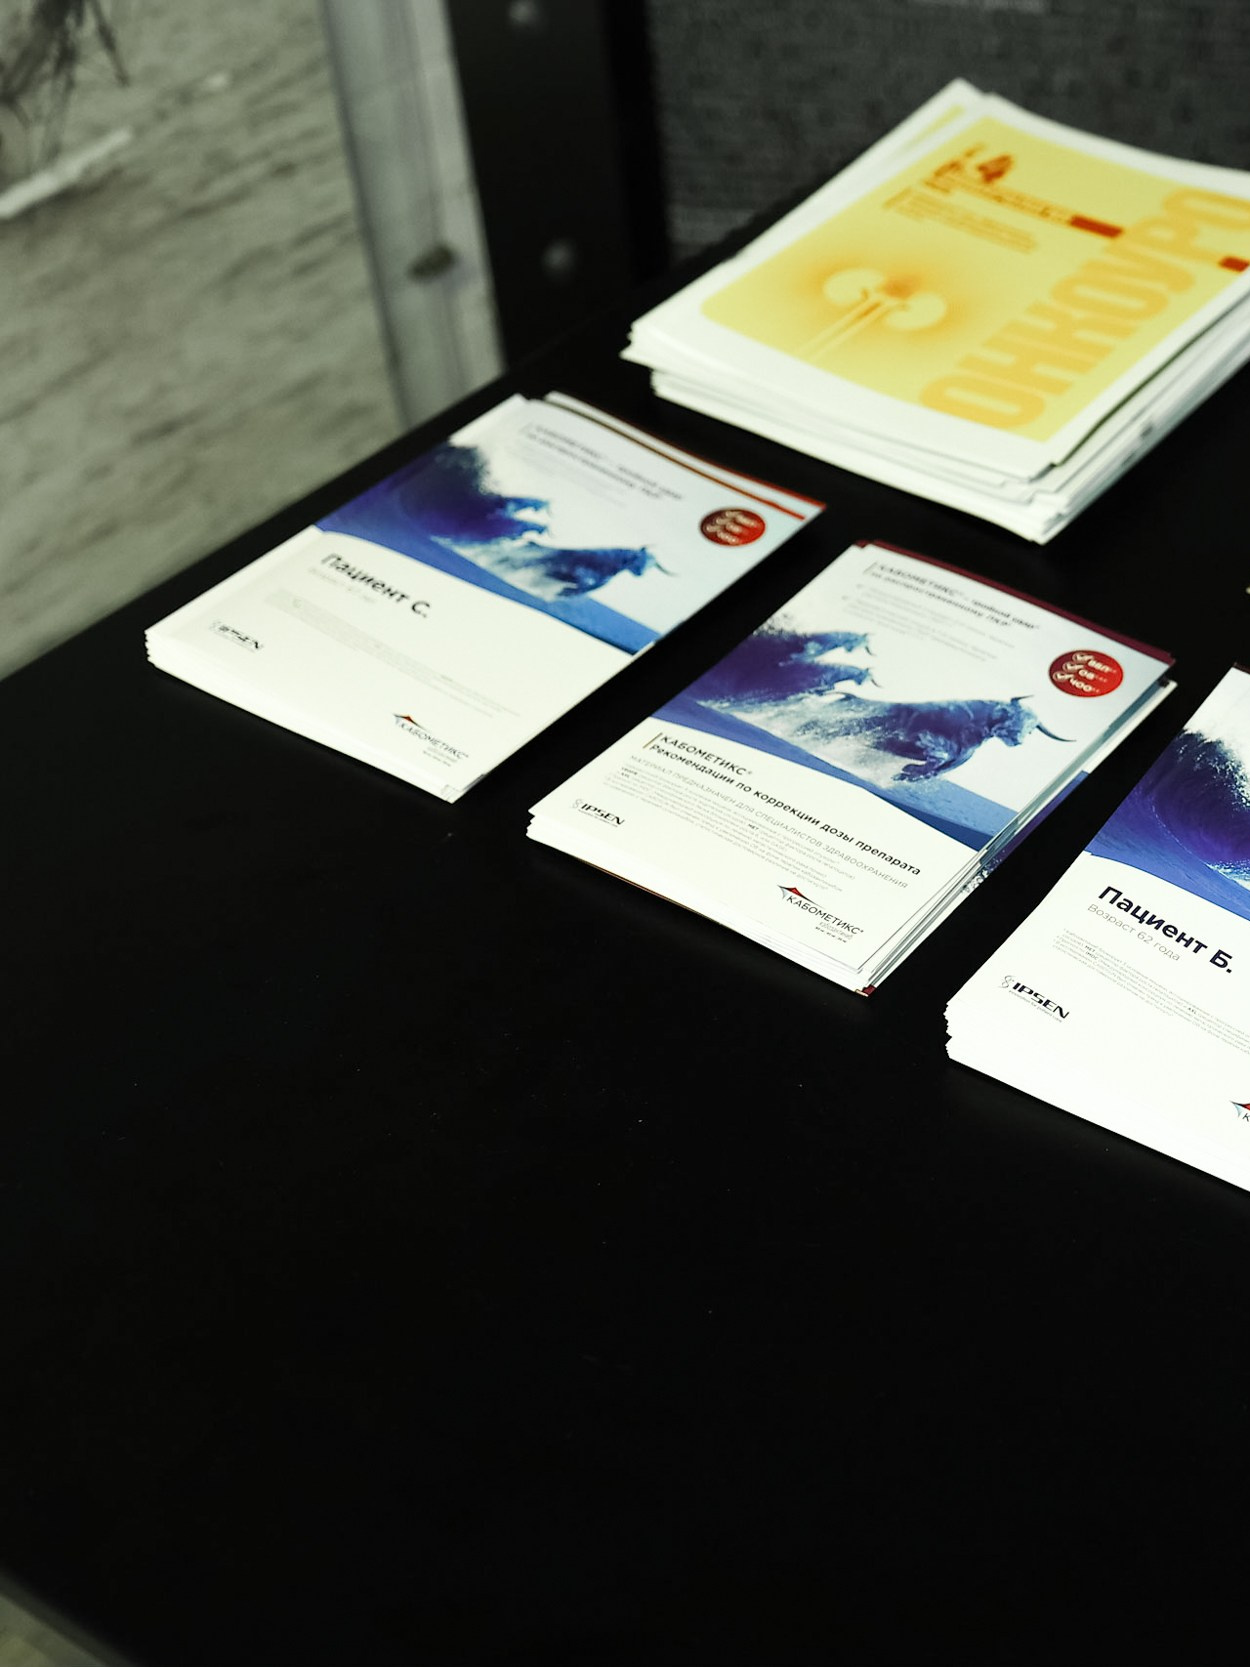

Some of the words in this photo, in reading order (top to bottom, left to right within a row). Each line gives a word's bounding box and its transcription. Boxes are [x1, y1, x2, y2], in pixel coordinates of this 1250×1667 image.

[317, 552, 410, 604] Пациент
[580, 803, 625, 825] IPSEN
[649, 744, 735, 785] Рекомендации
[733, 781, 753, 793] по
[751, 790, 821, 826] коррекции
[819, 822, 855, 842] дозы
[852, 839, 922, 876] препарата
[1086, 902, 1137, 934] Возраст
[1134, 930, 1155, 944] 62
[1152, 941, 1182, 961] года
[1097, 885, 1208, 956] Пациент
[1208, 948, 1240, 973] Б.
[1011, 981, 1070, 1019] IPSEN
